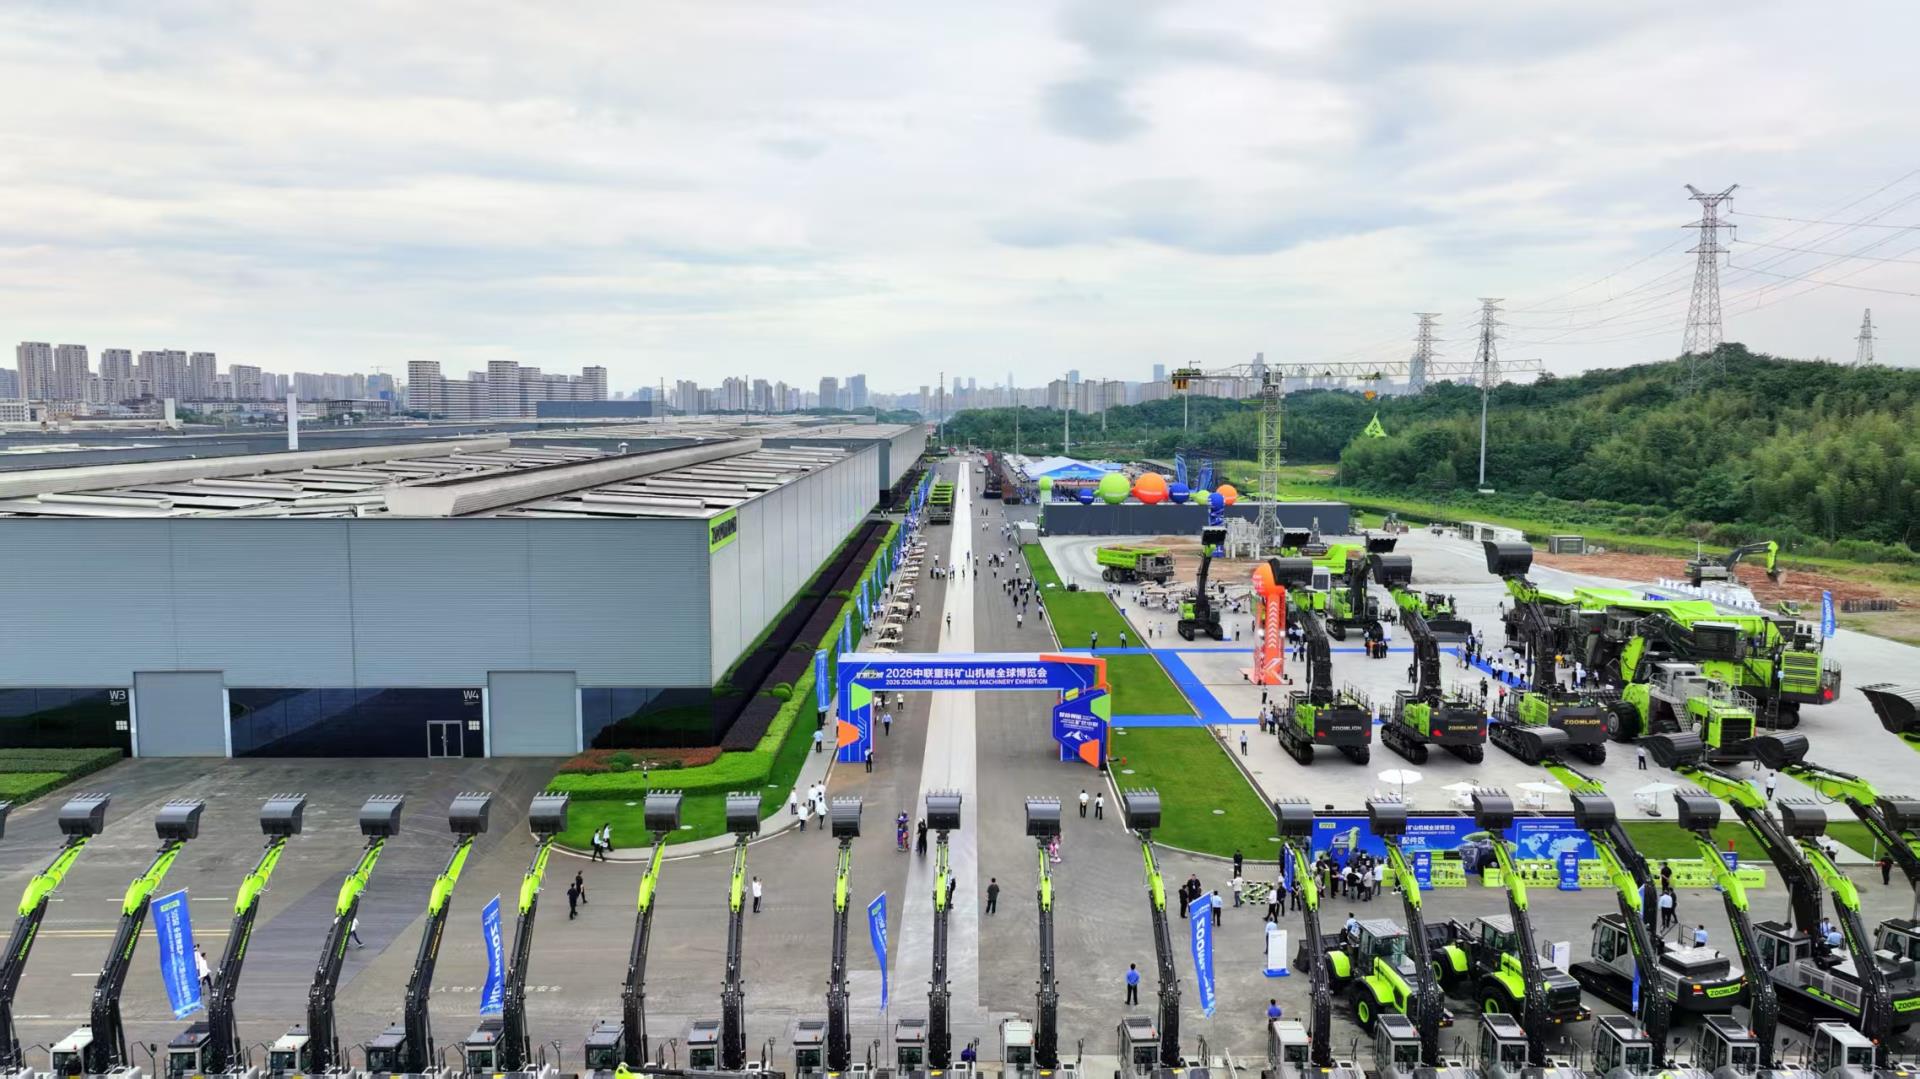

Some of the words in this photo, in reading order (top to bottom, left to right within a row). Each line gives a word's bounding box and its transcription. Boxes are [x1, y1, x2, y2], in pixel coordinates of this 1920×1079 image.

[886, 667, 1047, 679] 2026中联重科矿山机械全球博览会
[109, 690, 126, 700] W3
[463, 690, 479, 700] W4
[1710, 986, 1738, 996] ZOOMLION
